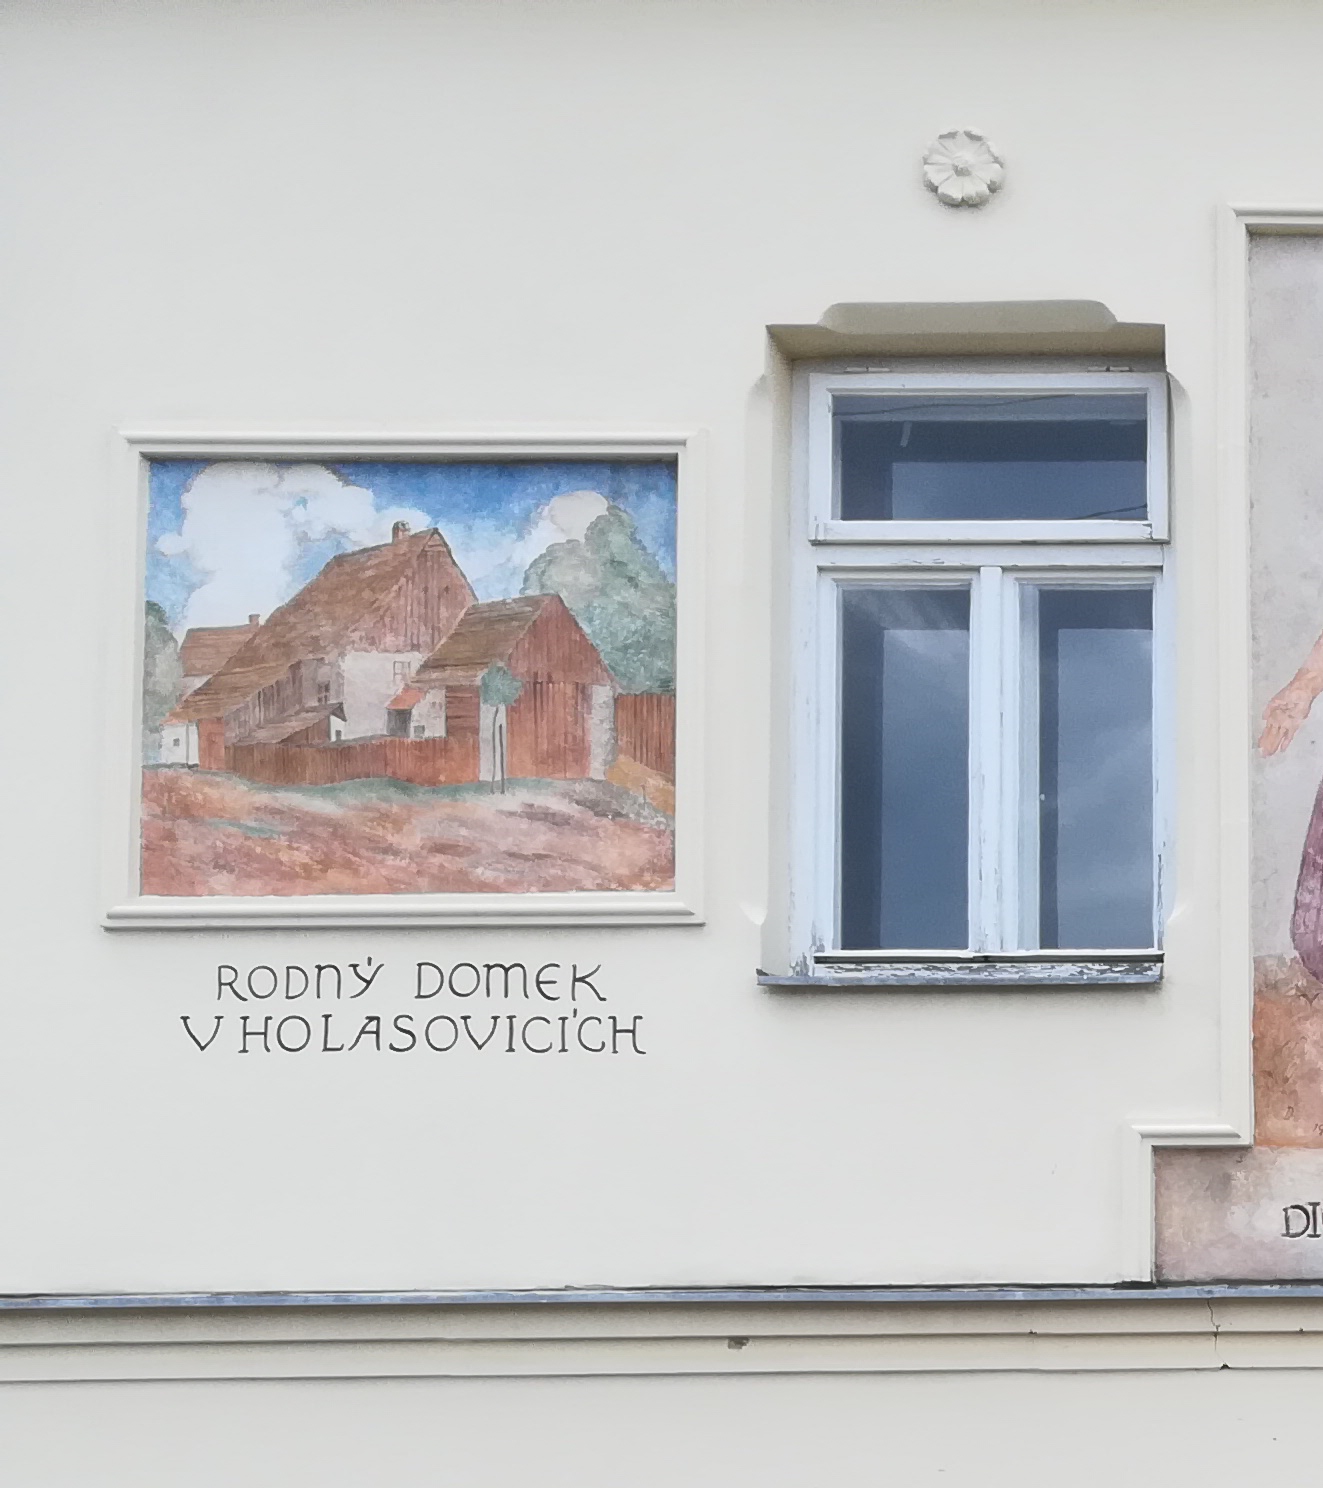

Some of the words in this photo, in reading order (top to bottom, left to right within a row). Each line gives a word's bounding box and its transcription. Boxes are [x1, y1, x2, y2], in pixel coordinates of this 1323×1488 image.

[217, 956, 385, 1002] RODNÝ
[413, 961, 607, 1002] DOMEK
[179, 1014, 225, 1052] V
[237, 1008, 647, 1056] HOLASOVICÍCH
